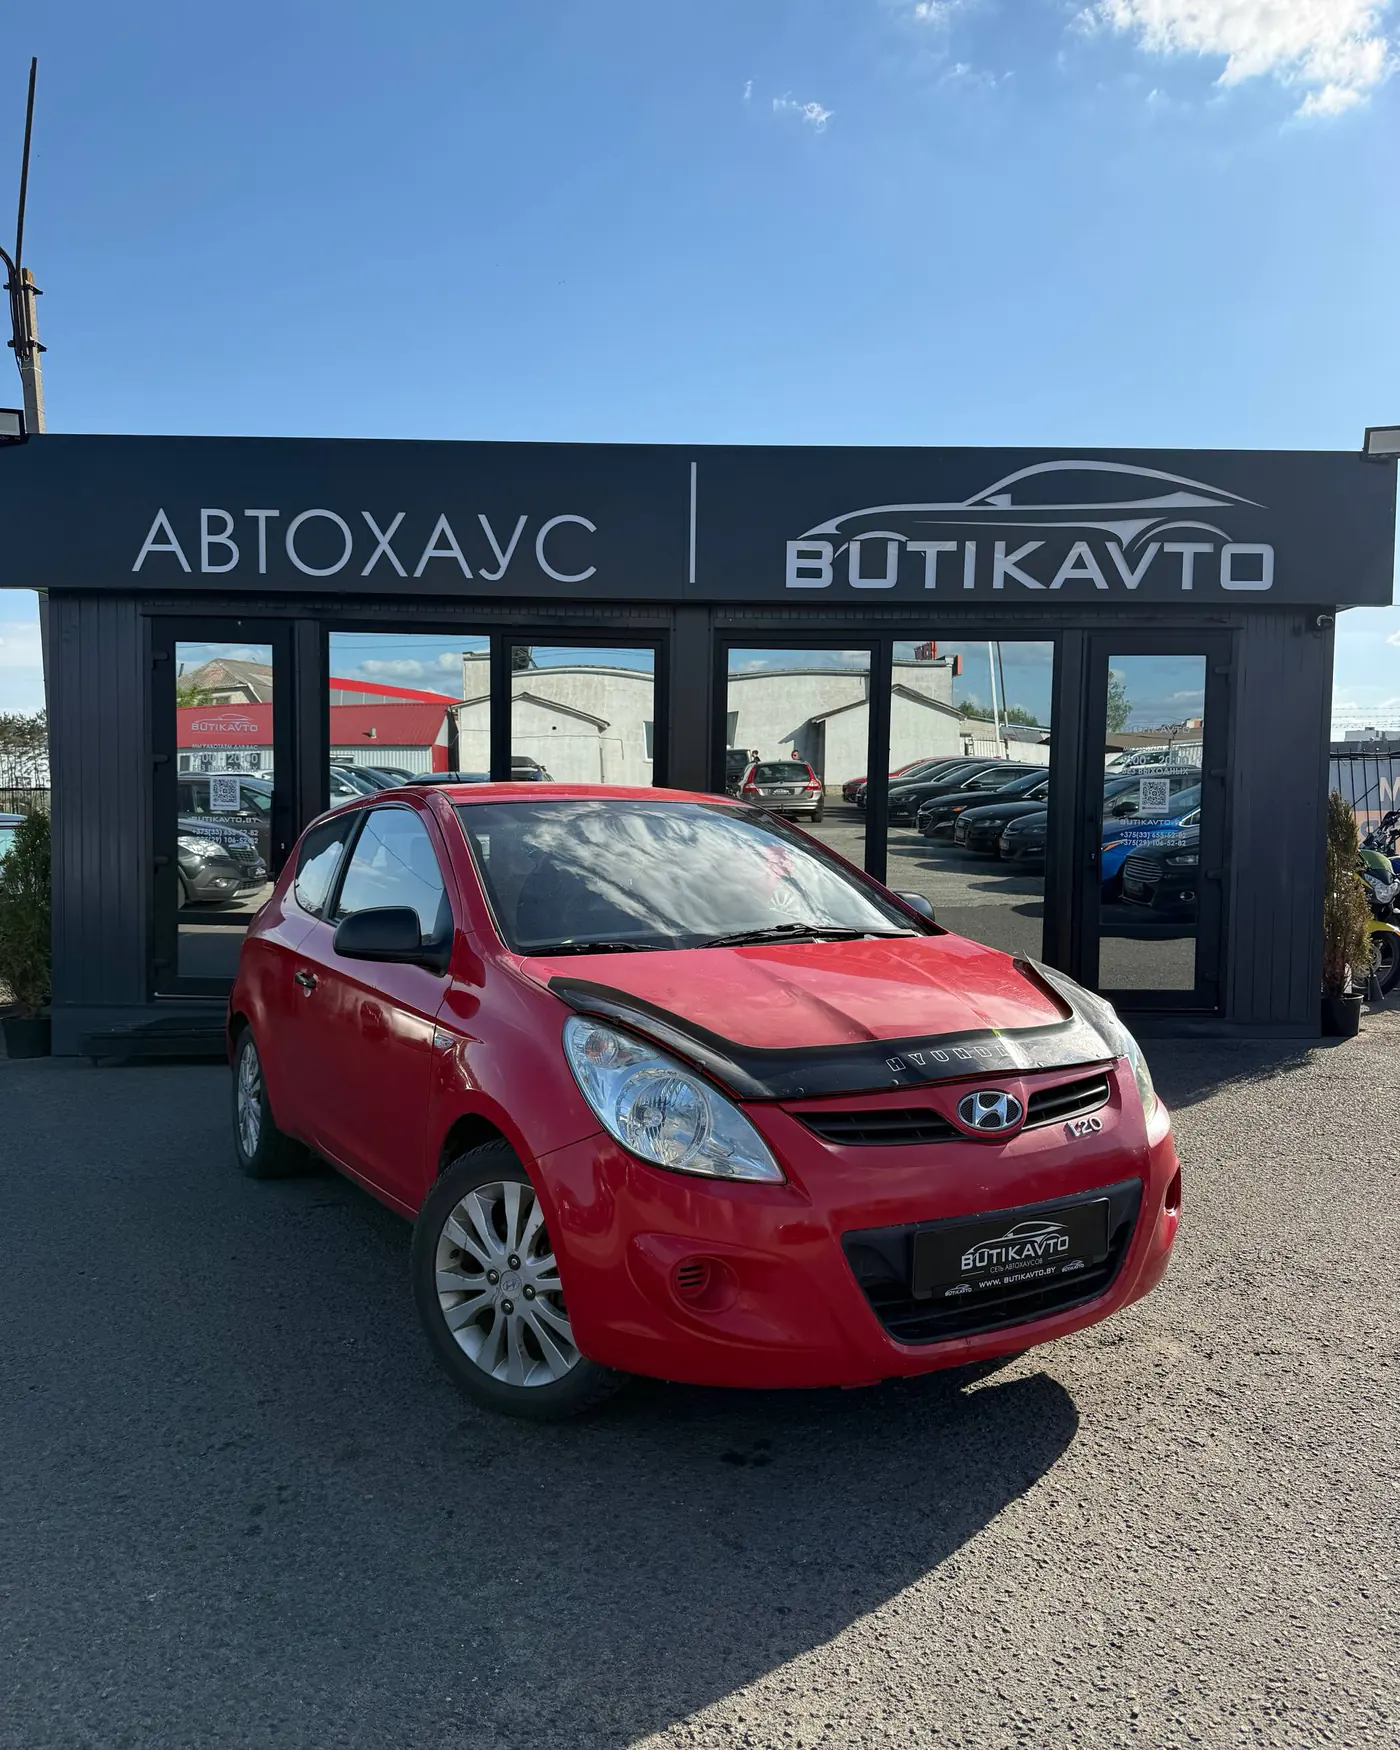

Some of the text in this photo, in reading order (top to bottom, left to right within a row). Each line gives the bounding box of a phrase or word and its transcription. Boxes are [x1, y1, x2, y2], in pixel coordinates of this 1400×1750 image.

[132, 507, 598, 583] АВТОХАУС
[785, 540, 1275, 591] BUTIKAVTO
[191, 722, 258, 732] BUTIKAVTO
[228, 753, 258, 763] 20:00
[1138, 767, 1188, 775] ВЫХОДНЫХ
[1120, 831, 1150, 839] +375(33)
[886, 1043, 1012, 1072] HYUND
[961, 1236, 1069, 1271] BUTIKAVTO
[1005, 1258, 1043, 1271] АВТОХАУСОВ
[979, 1266, 1056, 1288] WWW. BUTIKAVTO.BY
